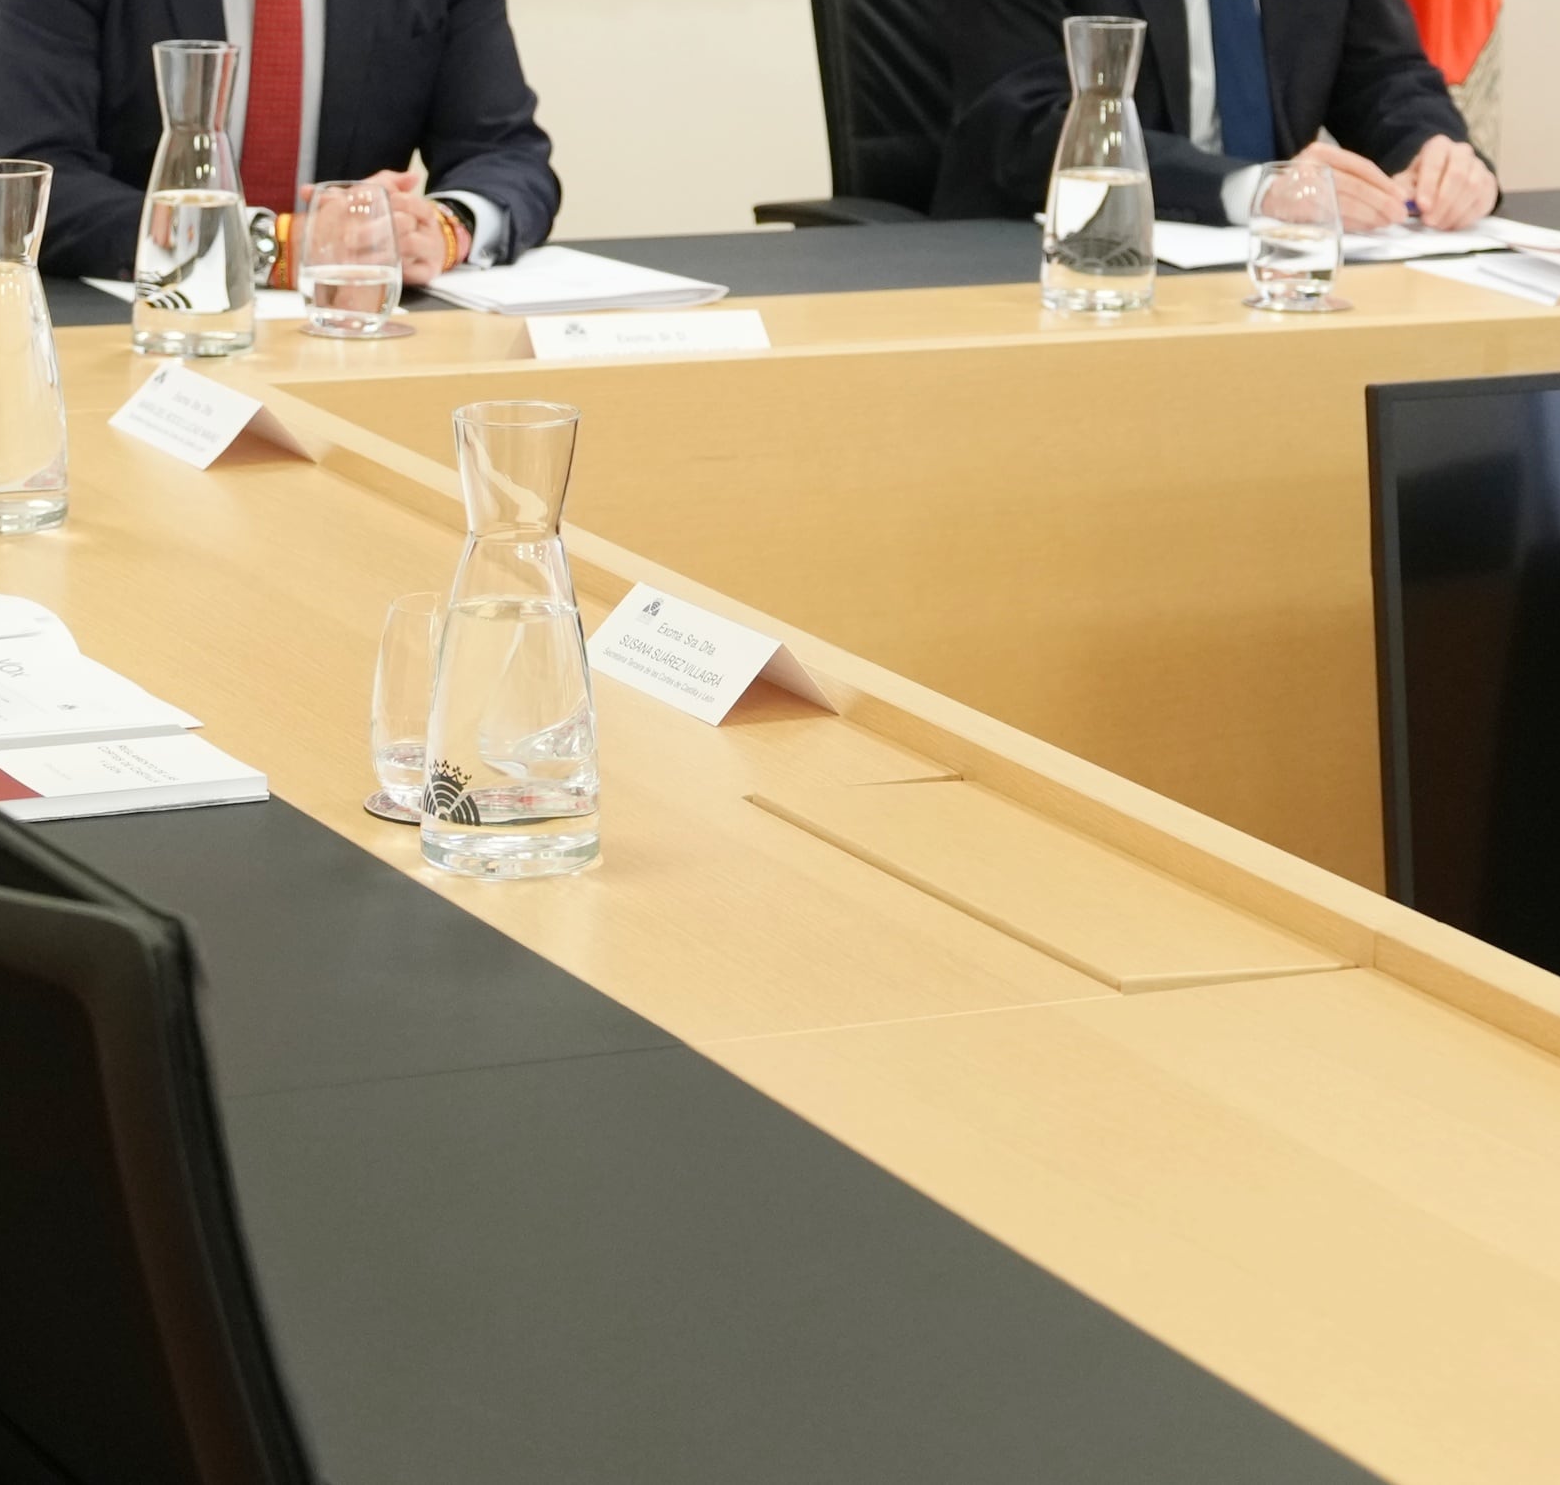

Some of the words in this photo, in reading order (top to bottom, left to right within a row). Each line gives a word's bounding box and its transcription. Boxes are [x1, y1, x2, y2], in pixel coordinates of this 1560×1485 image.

[619, 634, 653, 655] SUSANA
[651, 648, 686, 671] SUÁREZ
[683, 661, 725, 688] VILLAGRÁ
